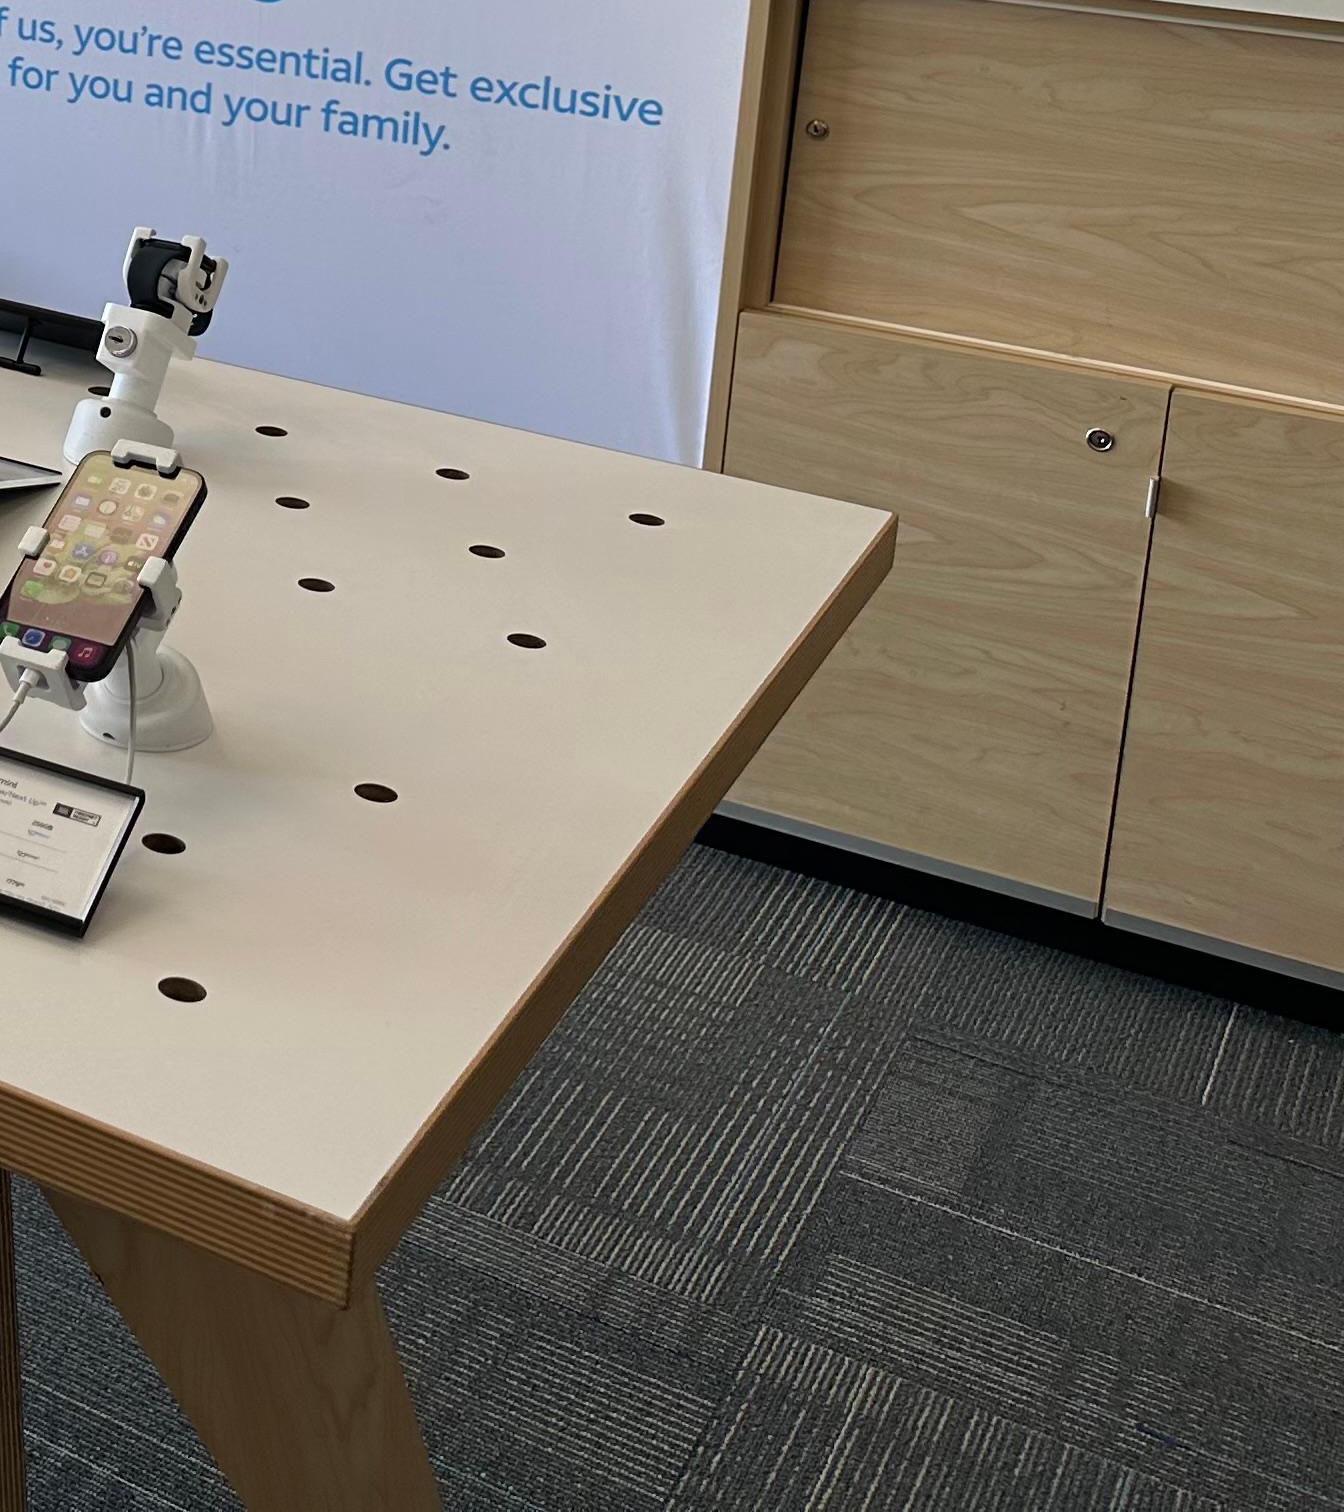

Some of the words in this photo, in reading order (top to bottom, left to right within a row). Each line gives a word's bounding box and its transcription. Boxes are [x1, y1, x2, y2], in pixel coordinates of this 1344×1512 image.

[8, 55, 60, 92] for
[68, 72, 134, 105] you
[143, 80, 213, 117] and
[224, 94, 311, 129] your
[322, 98, 451, 158] family.
[16, 18, 65, 50] us,
[193, 40, 371, 86] essential.
[384, 58, 456, 99] Get
[469, 76, 664, 128] exclusive
